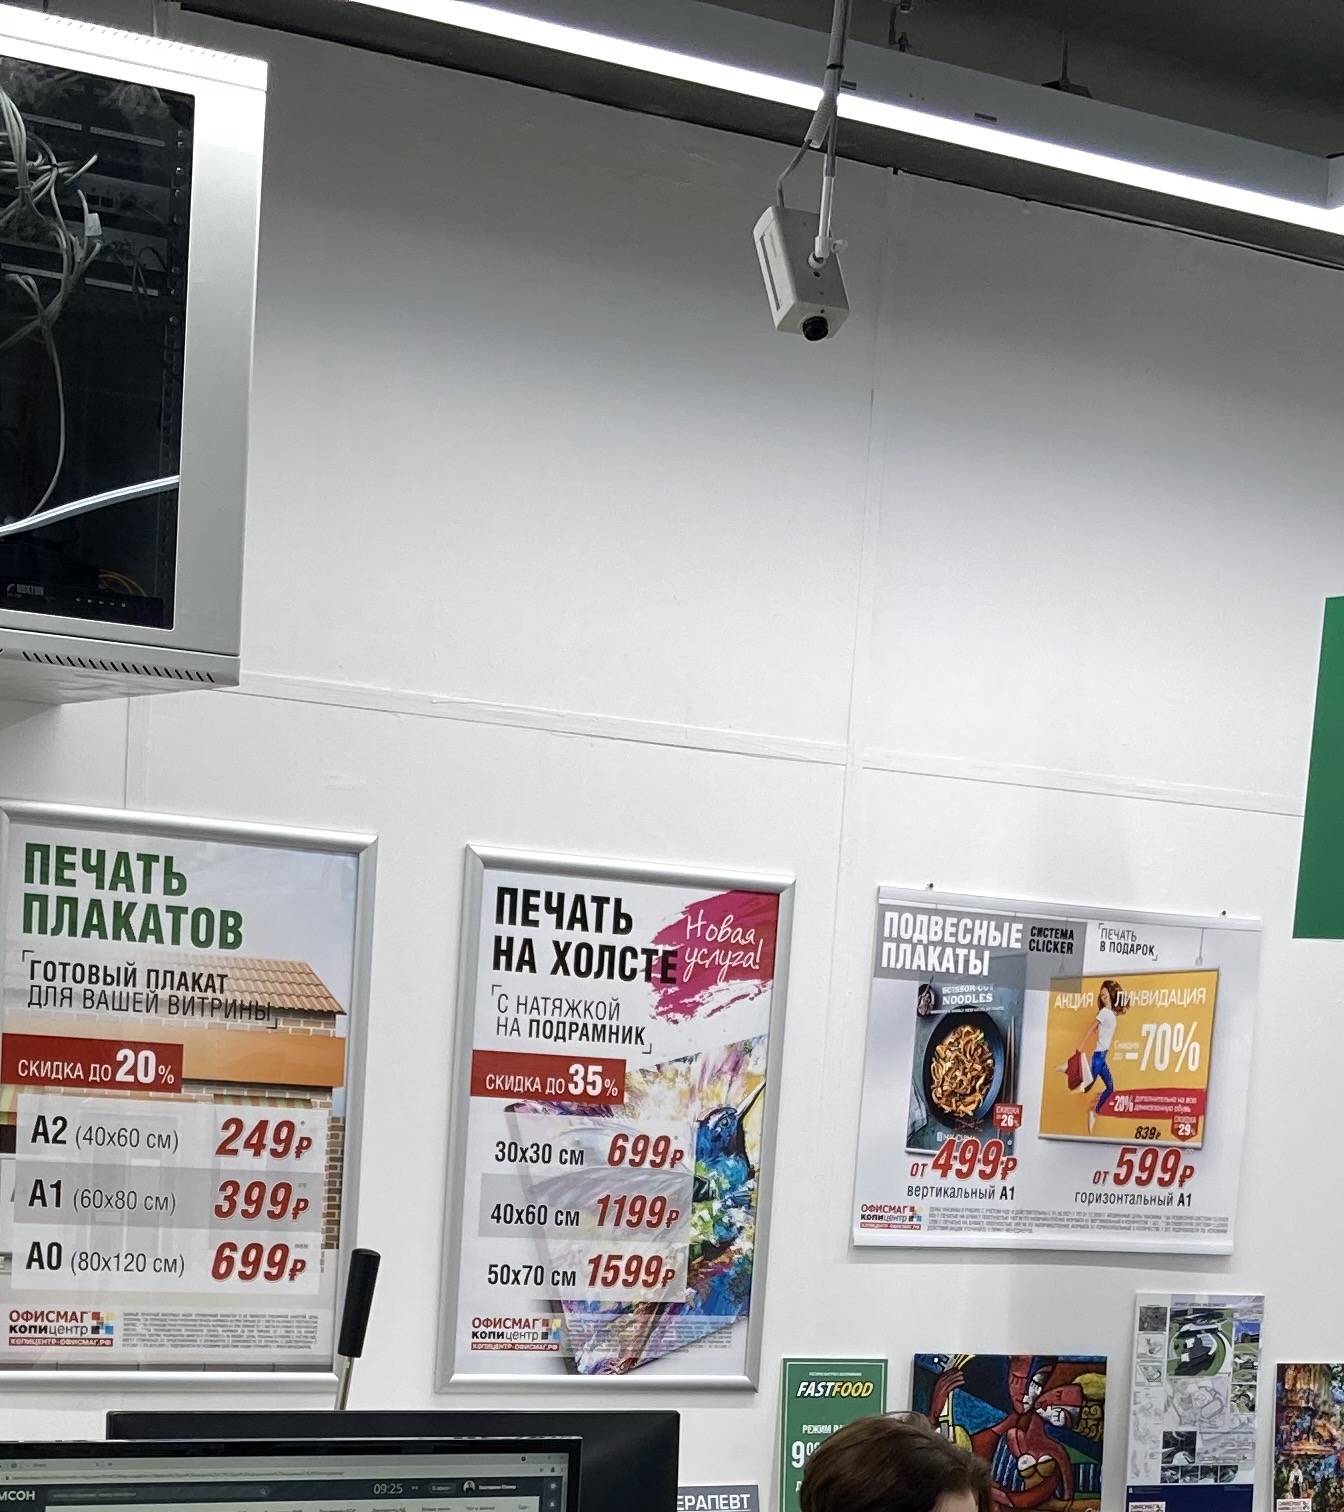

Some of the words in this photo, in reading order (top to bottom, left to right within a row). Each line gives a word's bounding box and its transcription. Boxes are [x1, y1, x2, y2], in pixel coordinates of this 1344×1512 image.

[24, 841, 188, 897] ПЕЧАТЬ
[494, 885, 633, 937] ПЕЧАТЬ
[22, 893, 244, 950] ПЛАКАТОВ
[684, 910, 759, 948] Новая
[883, 911, 1024, 950] ПОДВЕСНЫЕ
[1030, 925, 1075, 942] СИСТЕМА
[1100, 927, 1137, 942] ПЕЧАТЬ
[1028, 938, 1074, 955] CLICKER
[1108, 942, 1155, 958] ПОДАРОК
[491, 935, 538, 975] НА
[549, 940, 679, 986] ХОЛСТЕ
[880, 942, 990, 977] ПЛАКАТЫ
[30, 957, 139, 989] ГОТОВЫЙ
[146, 967, 229, 995] ПЛАКАТ
[28, 984, 76, 1010] ДЛЯ
[83, 986, 159, 1015] ВАШЕЙ
[168, 994, 272, 1022] ВИТРИНЫ
[942, 993, 993, 1006] NOODLES
[1054, 991, 1095, 1010] АКЦИЯ
[1114, 987, 1207, 1009] ЛИКВИДАЦИЯ
[496, 993, 510, 1014] С
[516, 993, 621, 1023] НАТЯЖКОЙ
[496, 1016, 522, 1039] НА
[527, 1018, 646, 1047] ПОДРАМНИК
[17, 1058, 84, 1083] СКИДКА
[88, 1061, 112, 1084] ДО
[115, 1048, 175, 1086] 20%
[485, 1072, 542, 1095] СКИДКА
[545, 1076, 565, 1097] ДО
[567, 1063, 619, 1098] 35%
[558, 1147, 584, 1166] см
[907, 1184, 995, 1200] вертикальный
[1074, 1191, 1174, 1207] горизонтальный
[553, 1208, 580, 1228] см
[861, 1203, 910, 1215] ОФИСМАГ
[550, 1269, 577, 1288] см
[9, 1310, 89, 1324] ОФИСМАГ
[471, 1316, 540, 1329] ОФИСМАГ
[9, 1323, 89, 1338] копицентр
[471, 1328, 539, 1342] копицентр
[795, 1380, 874, 1398] FASTFOOD
[373, 1483, 404, 1495] 09:25
[676, 1494, 751, 1511] ЕРАПЕВТ
